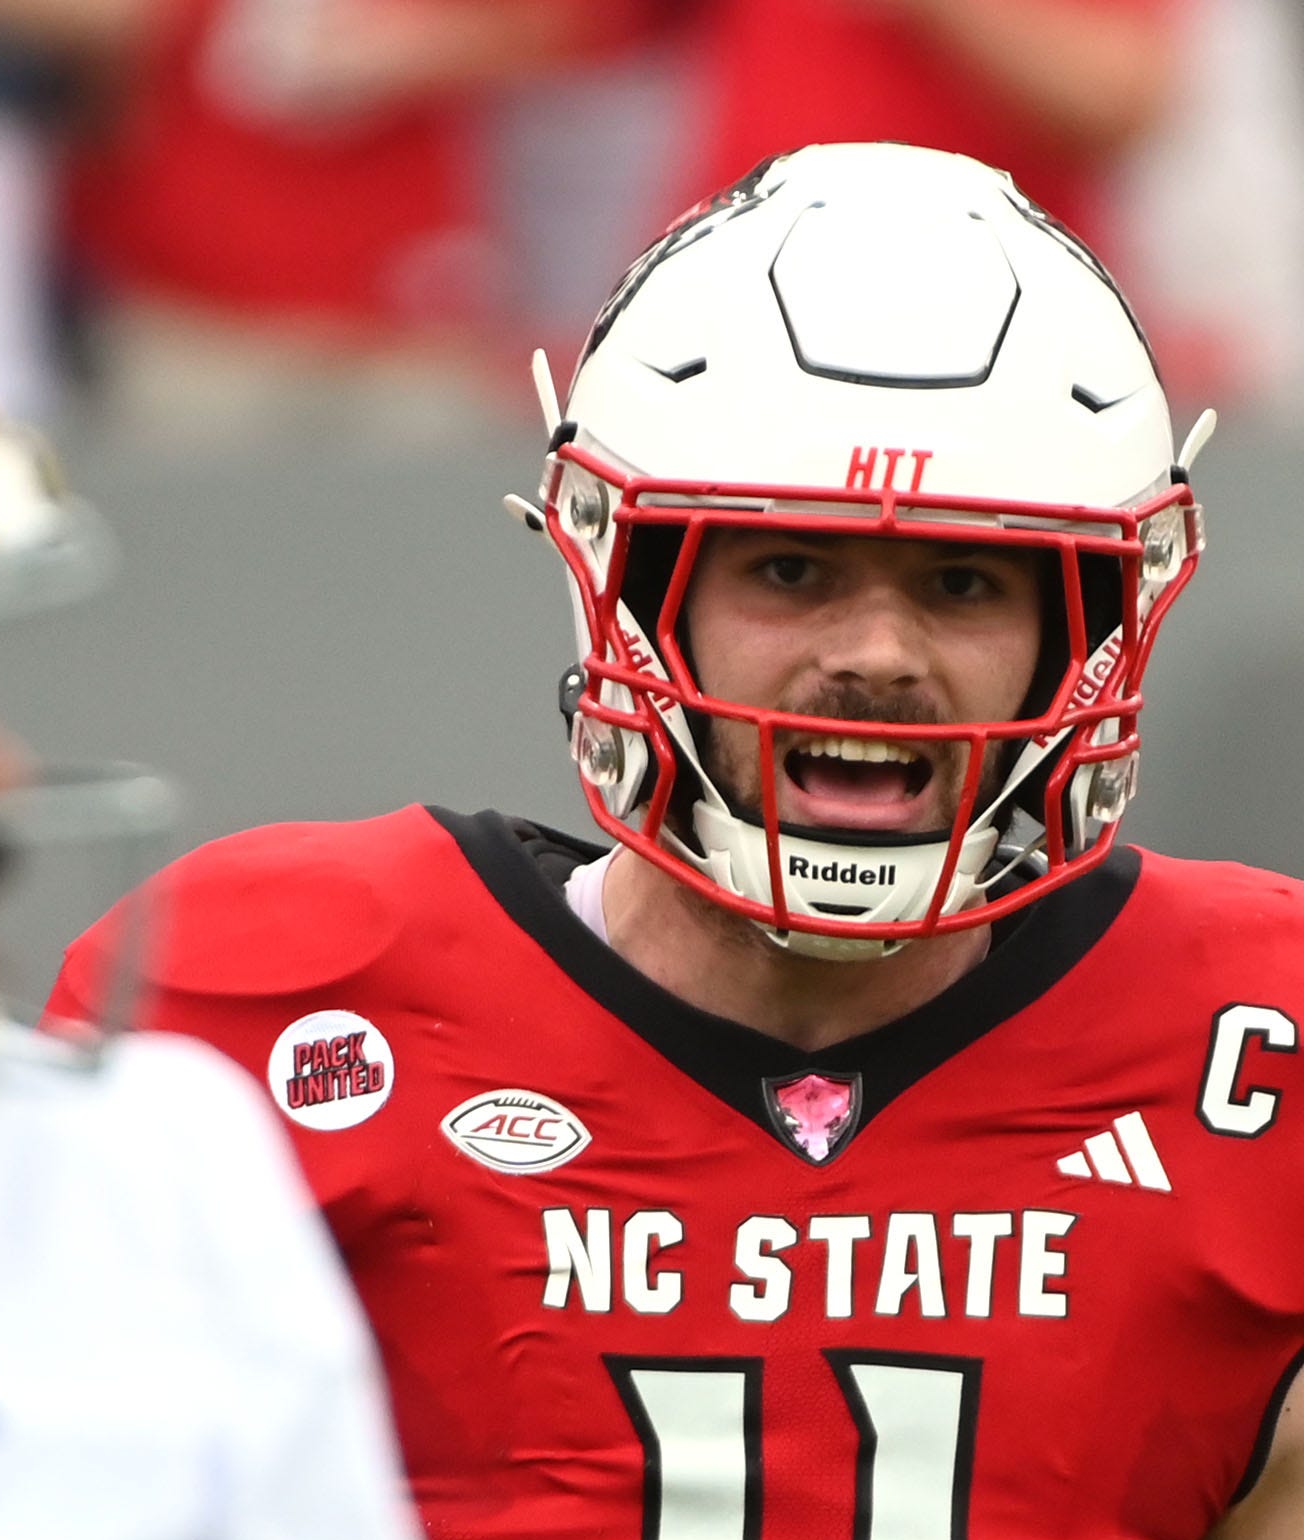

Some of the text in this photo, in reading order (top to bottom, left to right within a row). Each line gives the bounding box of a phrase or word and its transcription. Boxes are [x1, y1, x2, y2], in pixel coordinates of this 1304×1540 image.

[845, 446, 934, 493] HTT
[789, 855, 896, 886] Riddell
[293, 1031, 367, 1077] PACK
[1194, 1002, 1298, 1139] C
[286, 1061, 385, 1109] UNITED
[471, 1113, 564, 1141] ACC
[542, 1207, 1080, 1322] NC STATE
